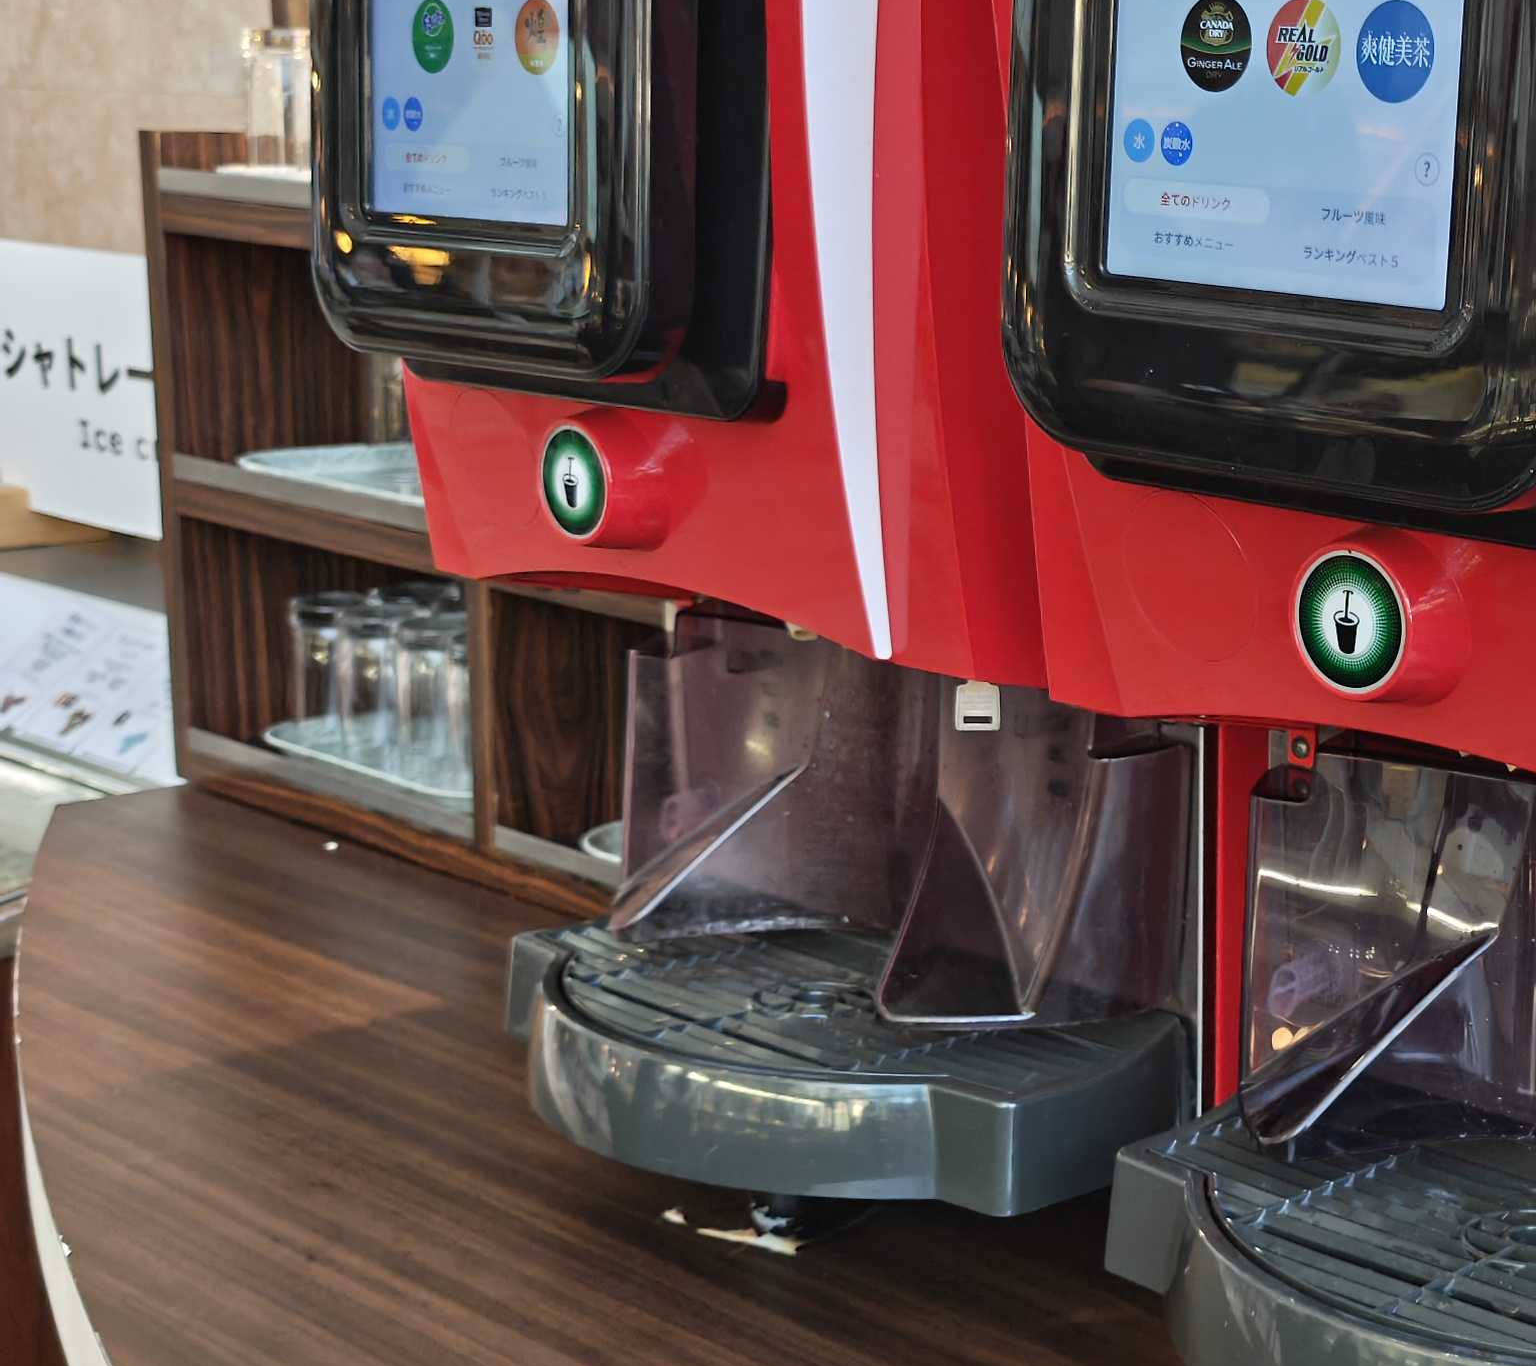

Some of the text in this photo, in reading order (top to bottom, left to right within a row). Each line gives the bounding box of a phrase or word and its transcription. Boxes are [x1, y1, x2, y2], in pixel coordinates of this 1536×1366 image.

[1200, 19, 1234, 31] CANADA
[1208, 29, 1225, 39] DRY
[1276, 20, 1317, 44] REAL
[1296, 41, 1329, 63] GOLD
[1360, 34, 1430, 67] 爽健美茶
[1133, 133, 1145, 149] 水
[1160, 192, 1231, 212] 全てのドリンク
[1153, 231, 1234, 252] おすすめメニュー
[79, 418, 123, 454] Ice
